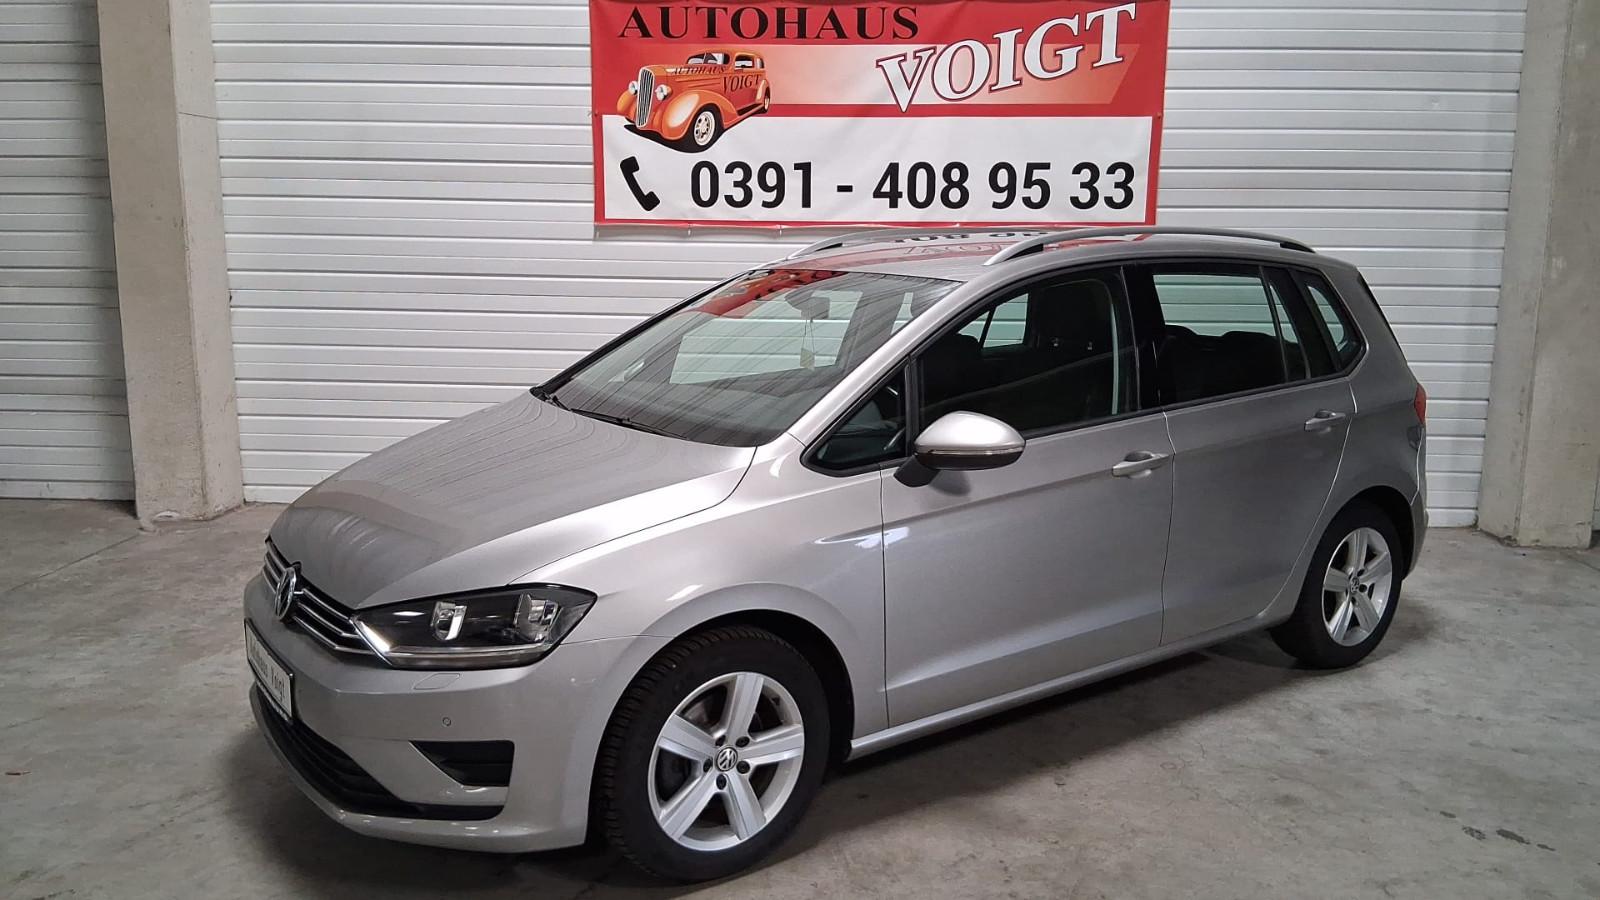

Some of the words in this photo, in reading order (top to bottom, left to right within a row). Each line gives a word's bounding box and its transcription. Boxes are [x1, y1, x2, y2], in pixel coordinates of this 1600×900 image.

[620, 7, 919, 39] AUTOHAUS
[673, 65, 728, 75] AUTOHAUS
[877, 3, 1137, 112] VOIGT
[723, 74, 763, 94] VOIGT
[690, 160, 812, 209] 0391
[872, 161, 970, 209] 408
[989, 161, 1051, 209] 95
[1070, 161, 1135, 209] 33
